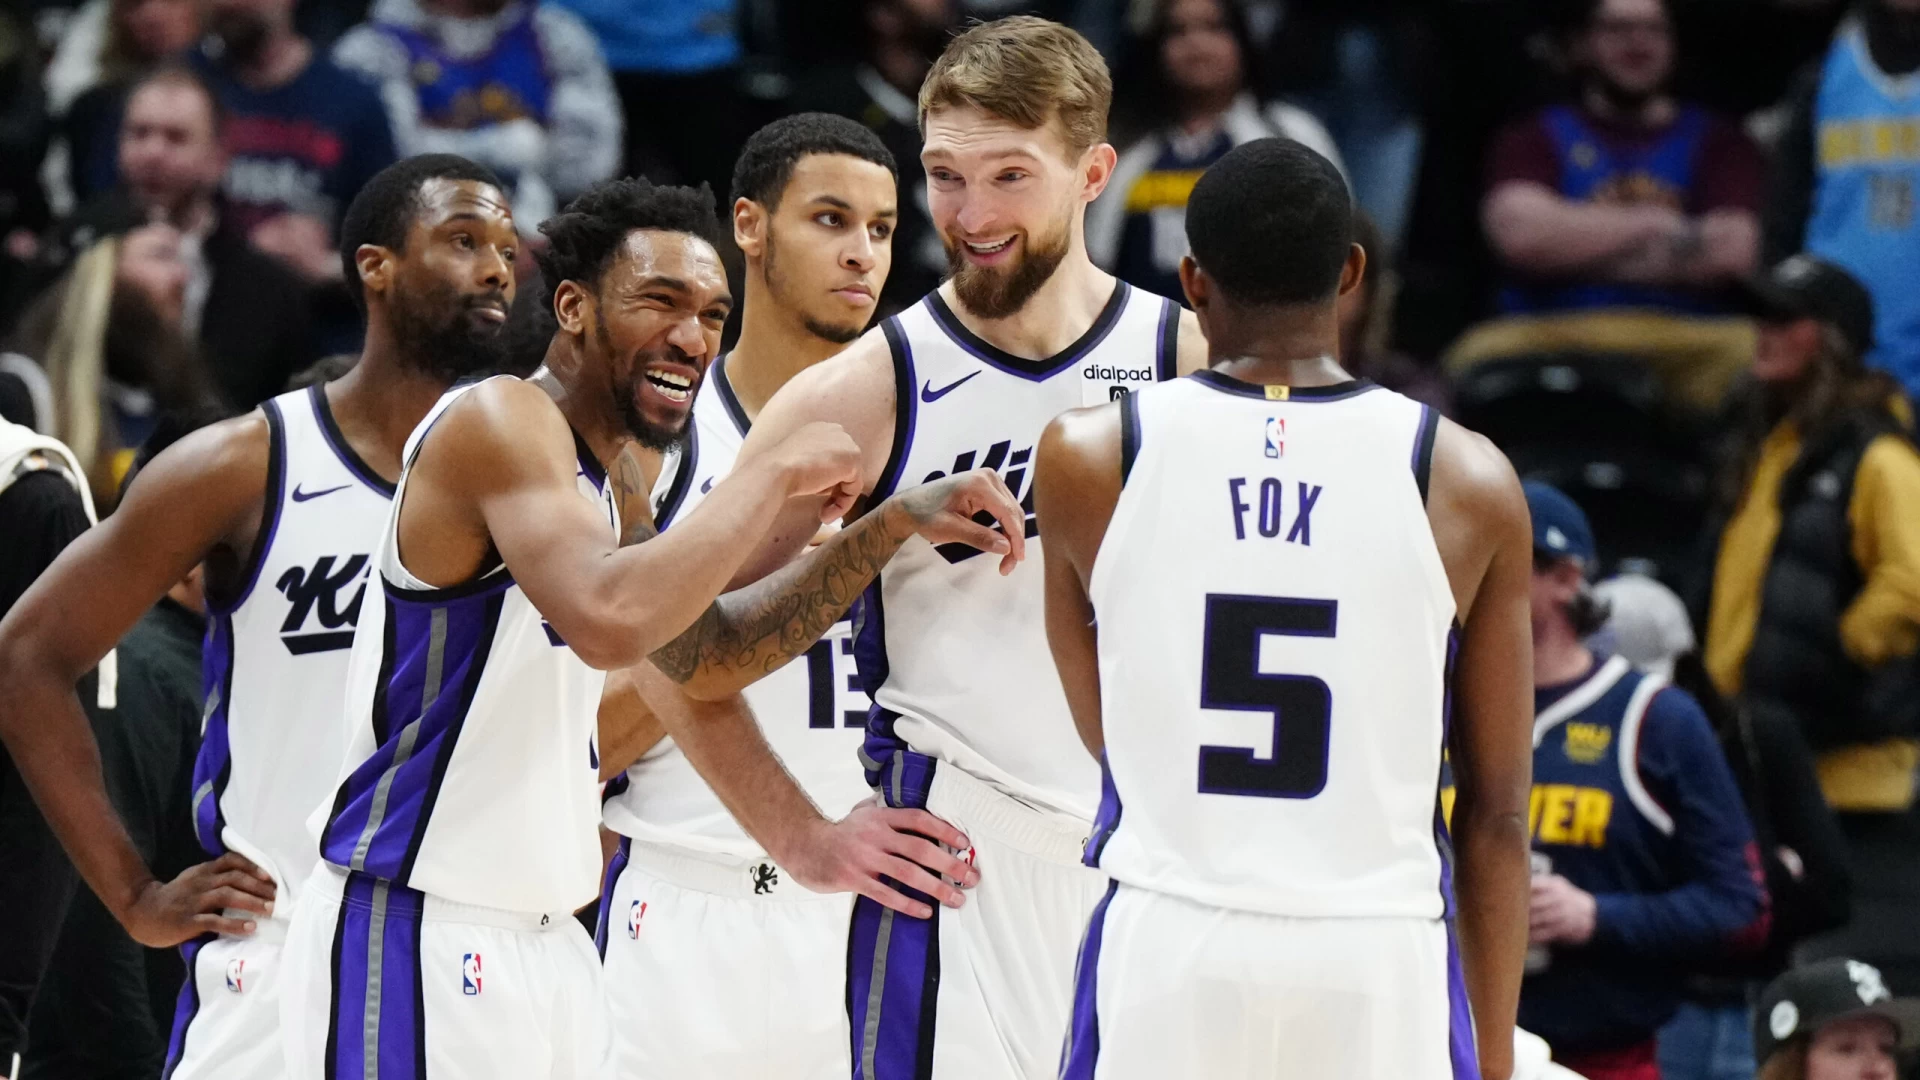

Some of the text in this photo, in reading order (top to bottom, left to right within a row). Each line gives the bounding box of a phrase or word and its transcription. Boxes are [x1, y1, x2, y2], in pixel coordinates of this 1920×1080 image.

[1083, 364, 1152, 384] dialpad
[1229, 477, 1323, 546] FOX
[1198, 593, 1338, 800] 5
